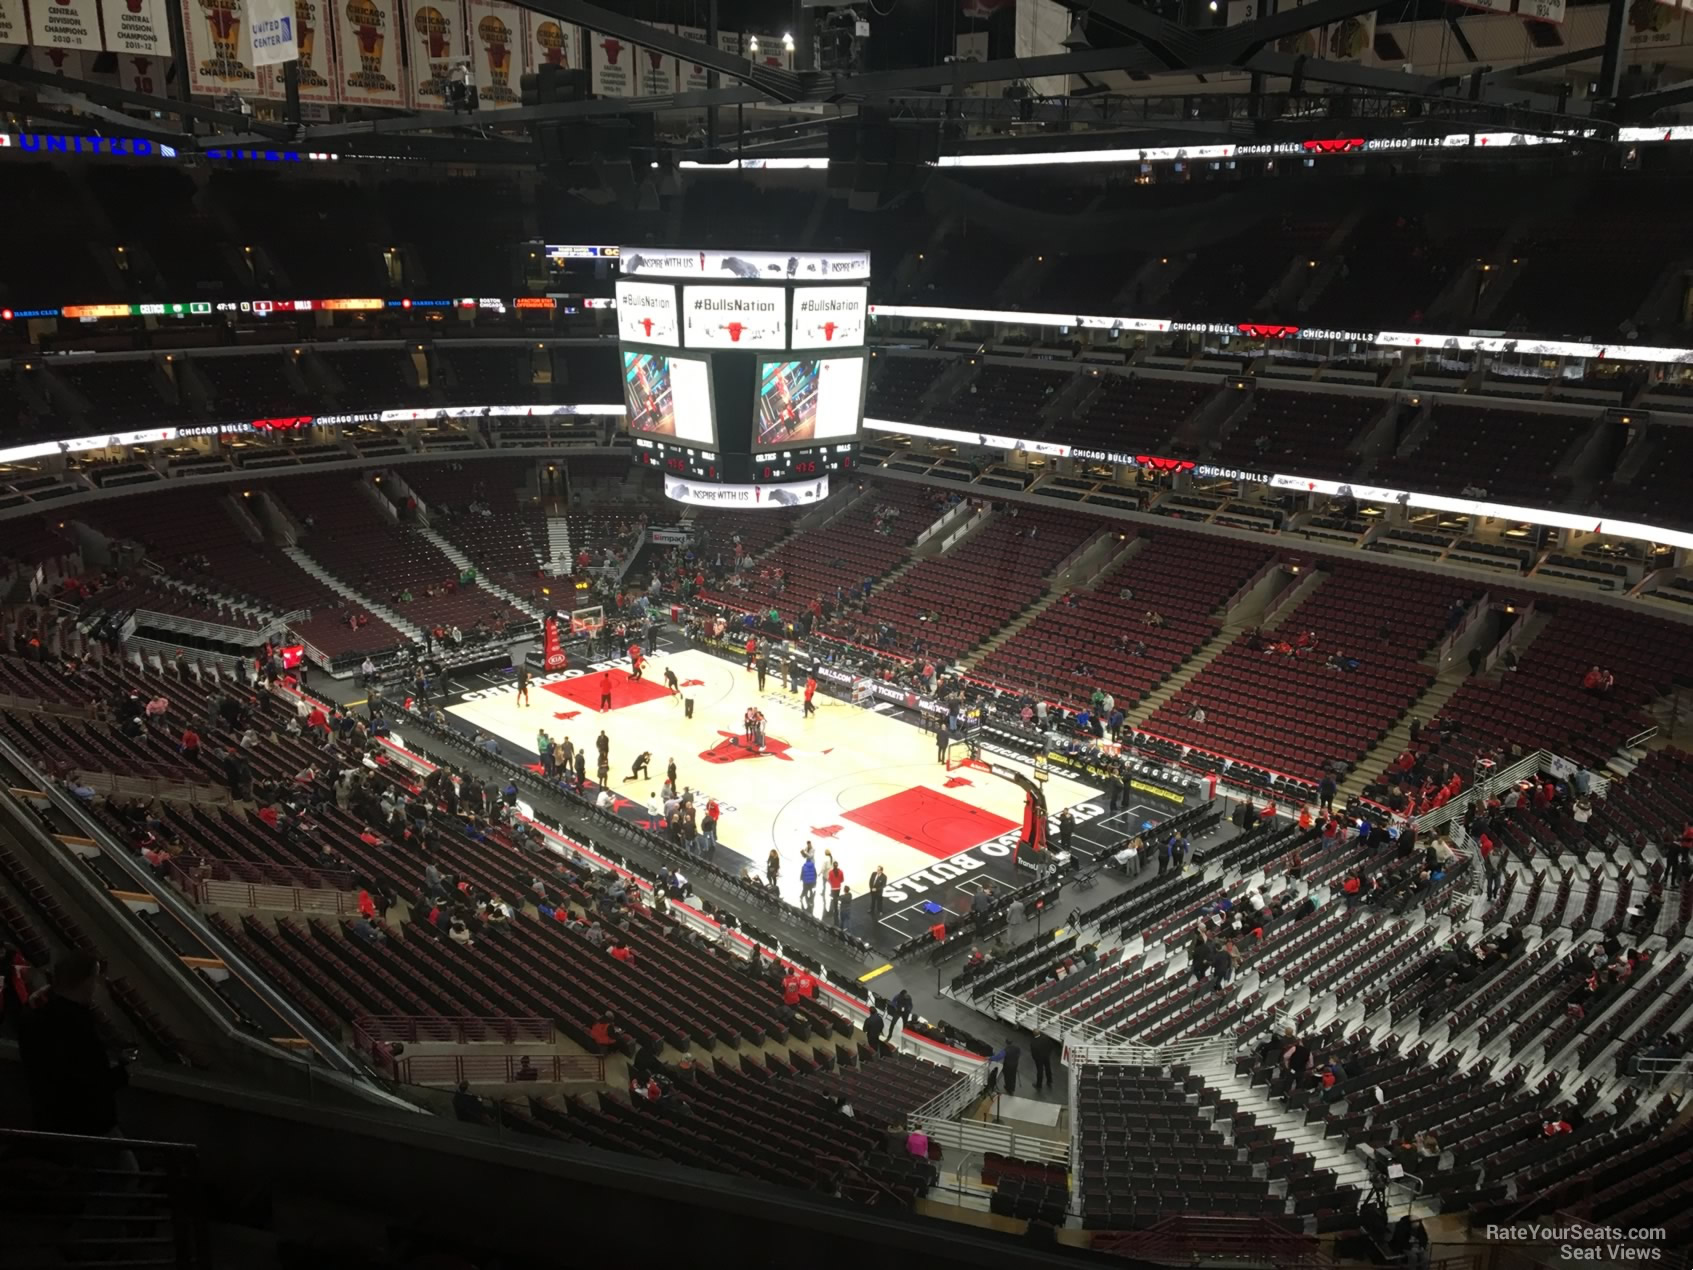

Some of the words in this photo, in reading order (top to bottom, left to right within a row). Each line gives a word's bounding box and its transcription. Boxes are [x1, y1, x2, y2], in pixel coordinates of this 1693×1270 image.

[48, 7, 78, 17] CENTRAL
[348, 5, 385, 18] CHICAGO
[1246, 5, 1252, 17] 3
[49, 16, 81, 26] DIVISION
[121, 14, 150, 24] CENTRAL
[45, 25, 88, 36] CHAMPIONS
[121, 23, 152, 32] DIVISION
[252, 20, 280, 34] UNITED
[480, 24, 513, 36] CHICAGO
[117, 31, 157, 42] CHAMPIONS
[253, 35, 281, 49] CENTER
[347, 79, 396, 91] CHAMPIONS
[19, 133, 152, 156] UNITED
[1238, 145, 1271, 154] CHICAGO
[1274, 143, 1299, 152] BULLS
[1369, 139, 1407, 149] CHICAGO
[1411, 138, 1440, 147] BULLS
[664, 257, 681, 267] WITH
[683, 258, 694, 268] US
[694, 298, 775, 311] #BullsNation
[801, 299, 859, 311] #BullsNation
[1173, 322, 1206, 331] CHICAGO
[1209, 323, 1233, 333] BULLS
[1303, 329, 1341, 339] CHICAGO
[1345, 332, 1373, 341] BULLS
[317, 416, 351, 425] CHICAGO
[354, 413, 378, 422] BULLS
[179, 426, 218, 437] CHICAGO
[221, 423, 248, 433] BULLS
[1073, 449, 1106, 460] CHICAGO
[1108, 453, 1132, 464] BULLS
[1199, 465, 1237, 478] CHICAGO
[1240, 471, 1268, 483] BULLS
[718, 490, 736, 500] WITH
[738, 491, 749, 501] US
[551, 655, 563, 664] KIA
[460, 669, 585, 701] CHIAGO
[818, 666, 851, 683] BULLS.COM
[878, 686, 904, 701] TICKETS
[980, 741, 1036, 765] CHICAGO
[882, 853, 986, 903] BULLS
